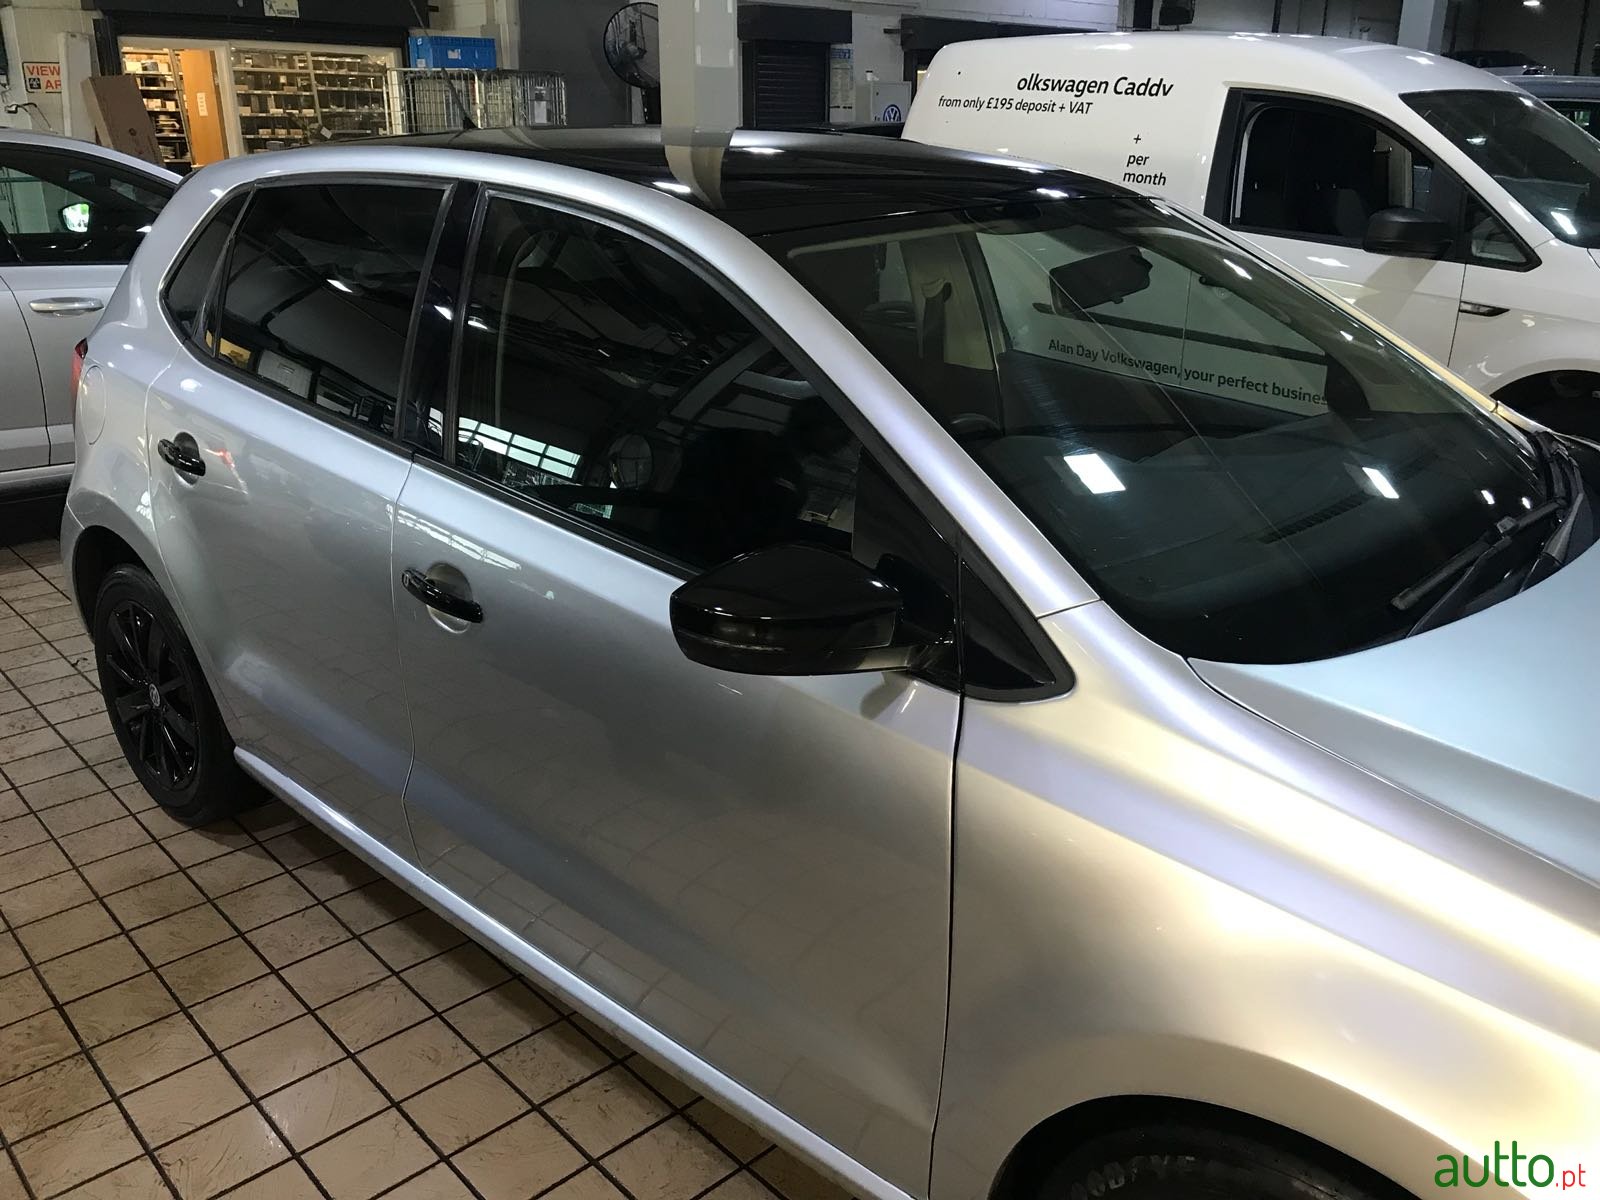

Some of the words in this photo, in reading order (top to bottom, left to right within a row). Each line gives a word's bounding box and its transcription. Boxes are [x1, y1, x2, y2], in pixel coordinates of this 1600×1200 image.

[938, 95, 963, 108] from
[963, 97, 985, 112] only
[986, 97, 1013, 110] £195
[1014, 98, 1055, 114] deposit
[1058, 103, 1066, 112] +
[1069, 101, 1093, 115] VAT
[1133, 134, 1142, 145] +
[1126, 152, 1150, 168] per
[1122, 171, 1168, 186] month
[1048, 339, 1075, 355] Alan
[1076, 344, 1099, 362] Day
[1101, 348, 1183, 378] Volkswagen,
[1183, 366, 1215, 383] your
[1217, 374, 1269, 395] perfect
